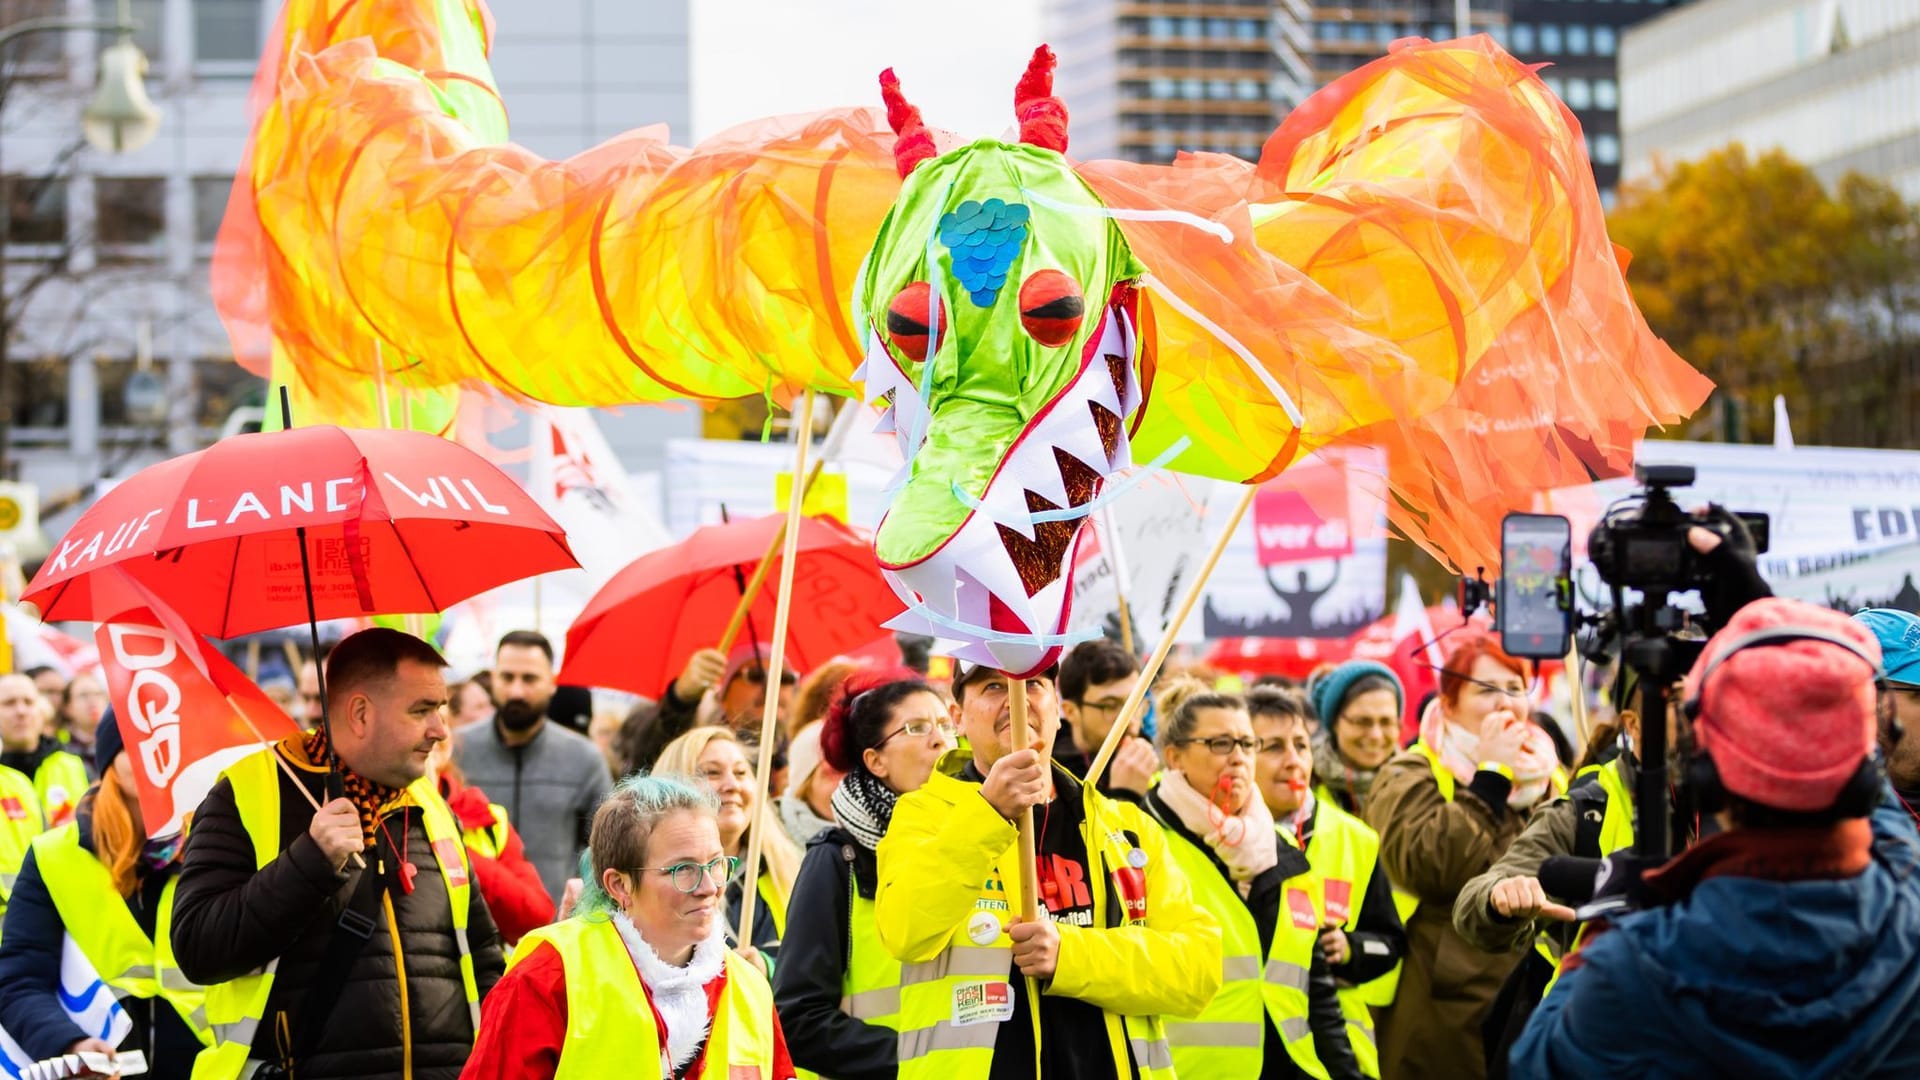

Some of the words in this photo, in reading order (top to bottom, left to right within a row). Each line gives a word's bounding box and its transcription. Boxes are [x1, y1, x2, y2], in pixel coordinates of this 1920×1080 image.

[47, 508, 163, 576] KAUF
[384, 472, 510, 515] WIL
[107, 623, 181, 789] DGB
